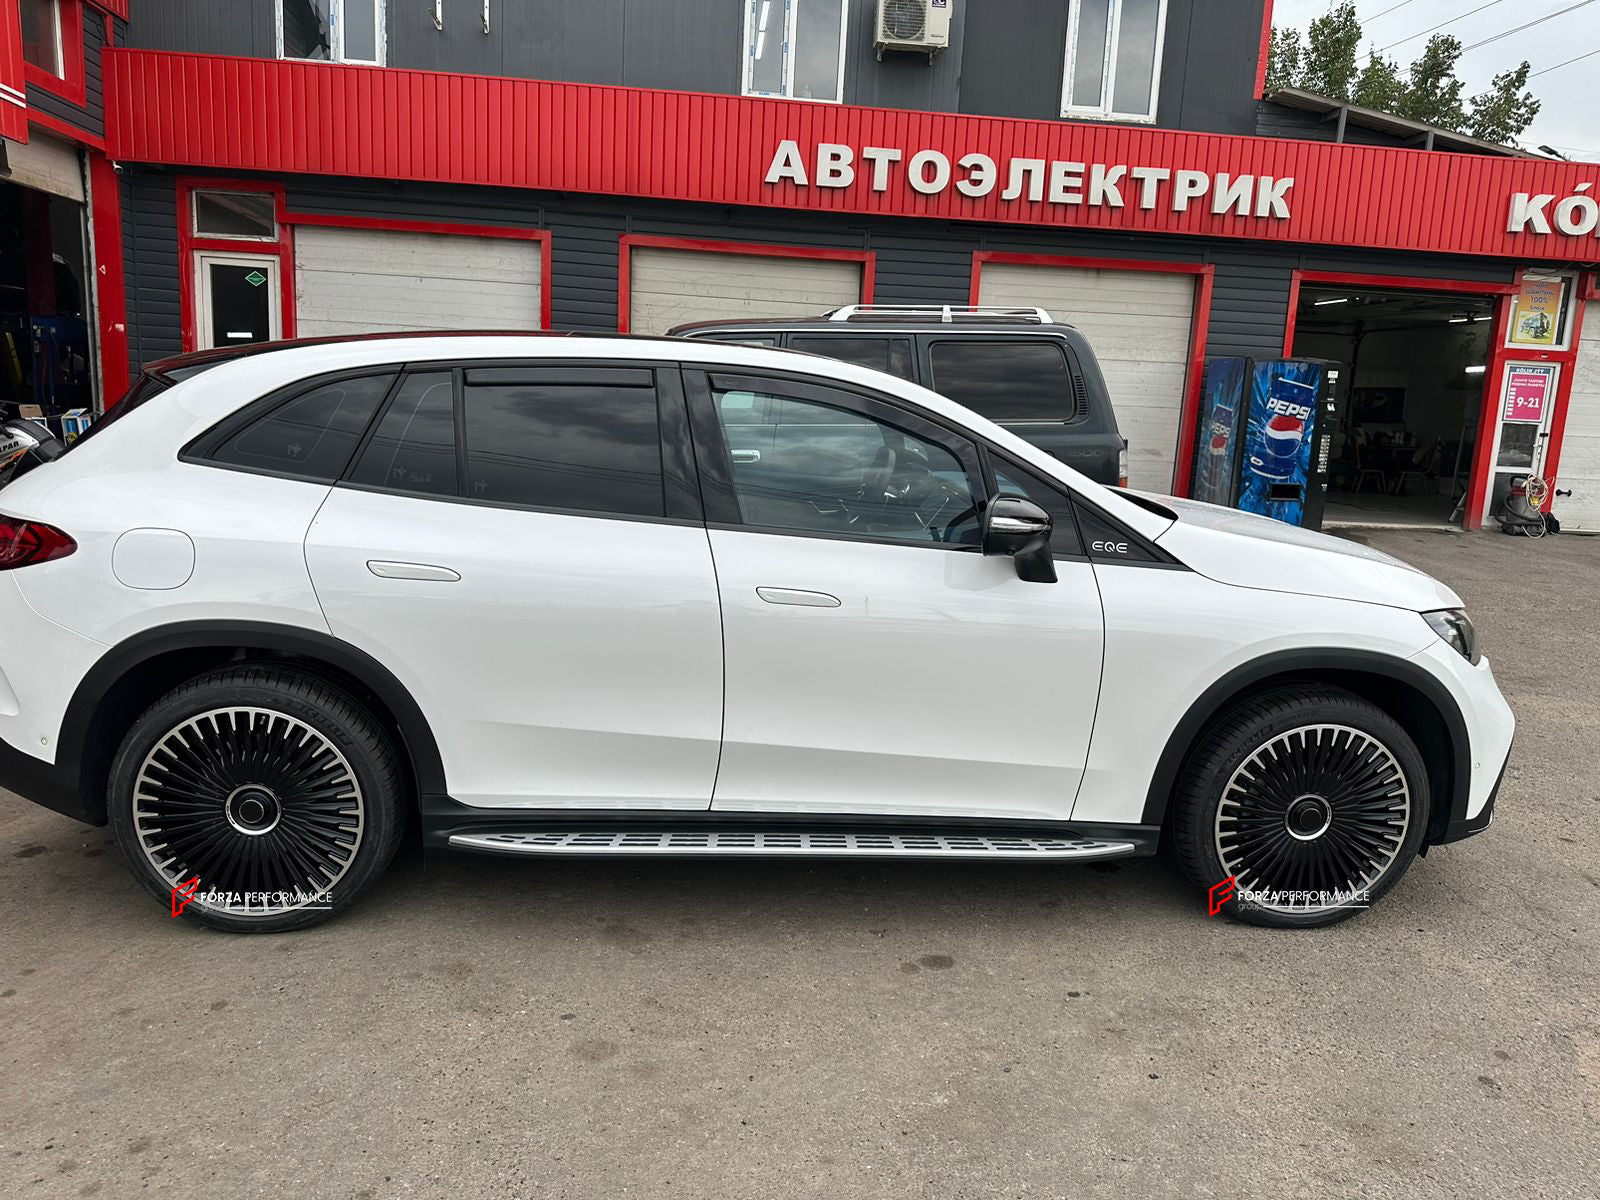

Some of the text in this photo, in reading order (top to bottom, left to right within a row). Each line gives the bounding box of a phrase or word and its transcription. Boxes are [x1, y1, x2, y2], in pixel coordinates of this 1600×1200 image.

[765, 139, 1294, 219] АВТОЭЛЕКТРИК
[1266, 397, 1311, 420] PEPSI
[1516, 396, 1540, 409] 9-21
[1092, 541, 1128, 554] EQE
